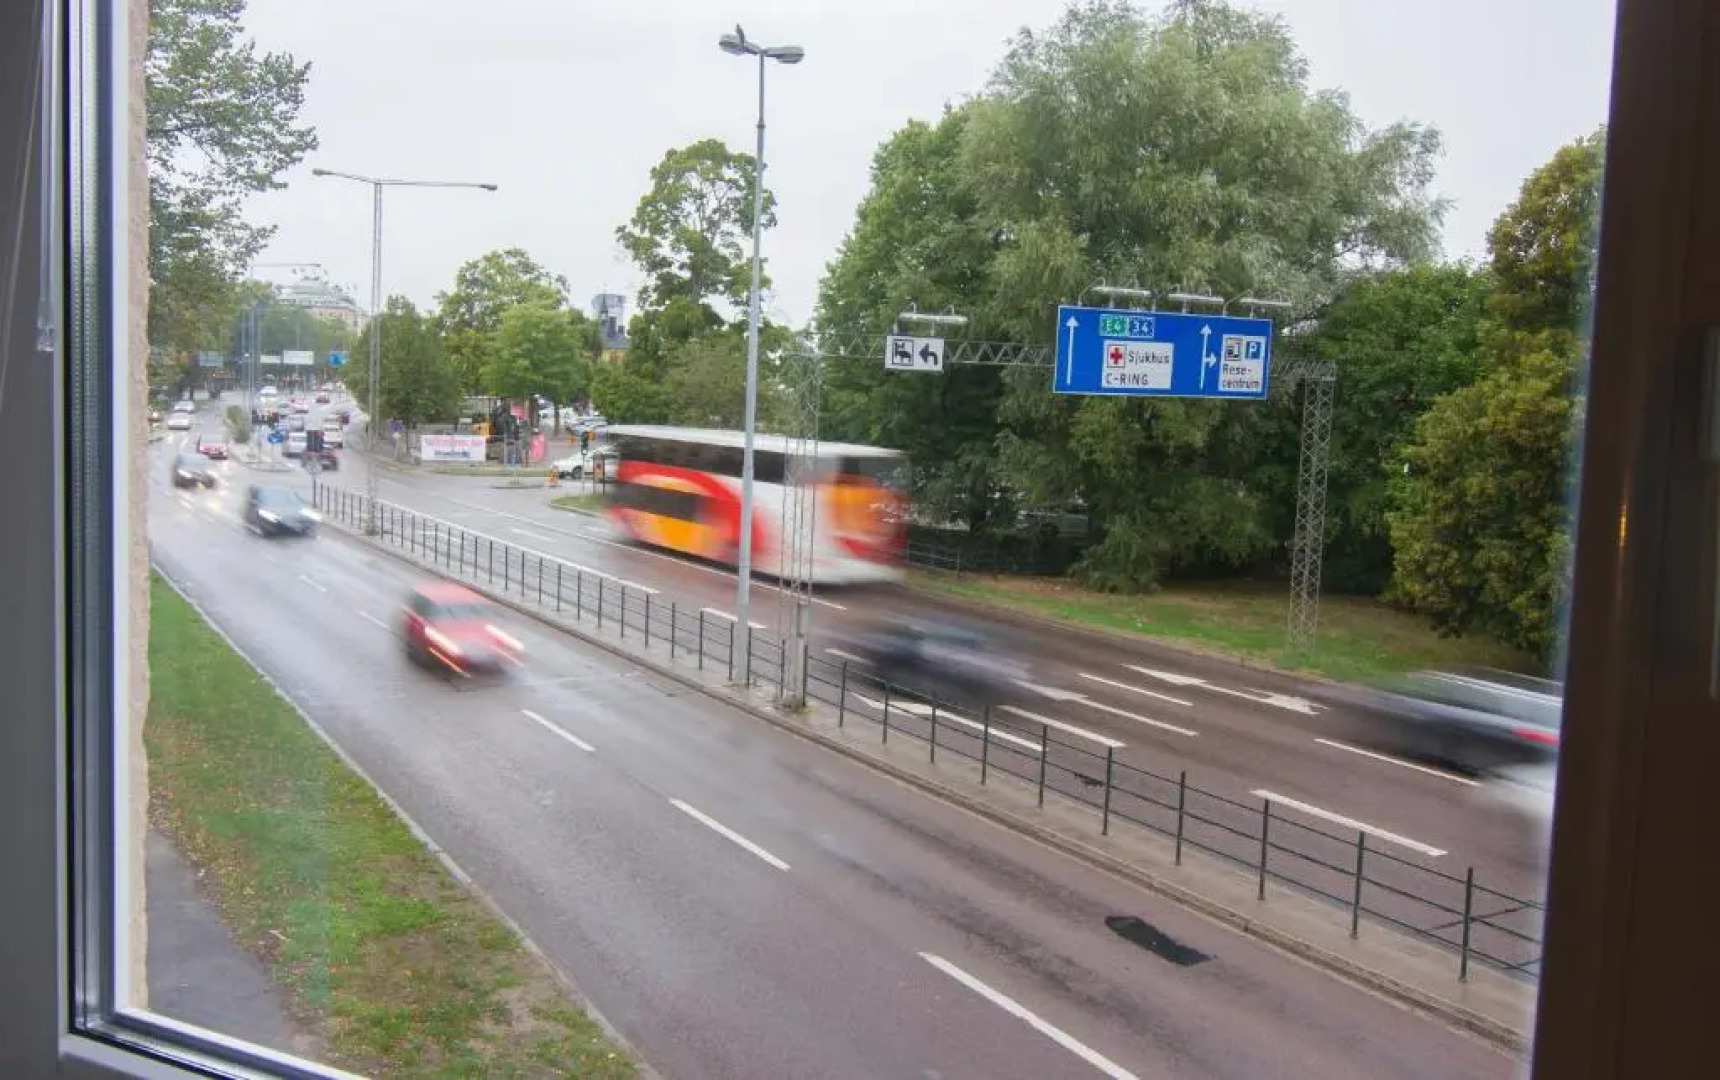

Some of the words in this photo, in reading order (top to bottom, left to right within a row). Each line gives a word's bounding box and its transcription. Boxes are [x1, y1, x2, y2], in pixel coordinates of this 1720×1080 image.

[1106, 320, 1121, 332] E4
[1133, 320, 1149, 333] 34
[1249, 344, 1258, 355] P
[1128, 350, 1170, 365] Sjukhus
[1222, 364, 1253, 376] Rese-
[1105, 373, 1149, 386] C-RING
[1221, 377, 1260, 389] centrum
